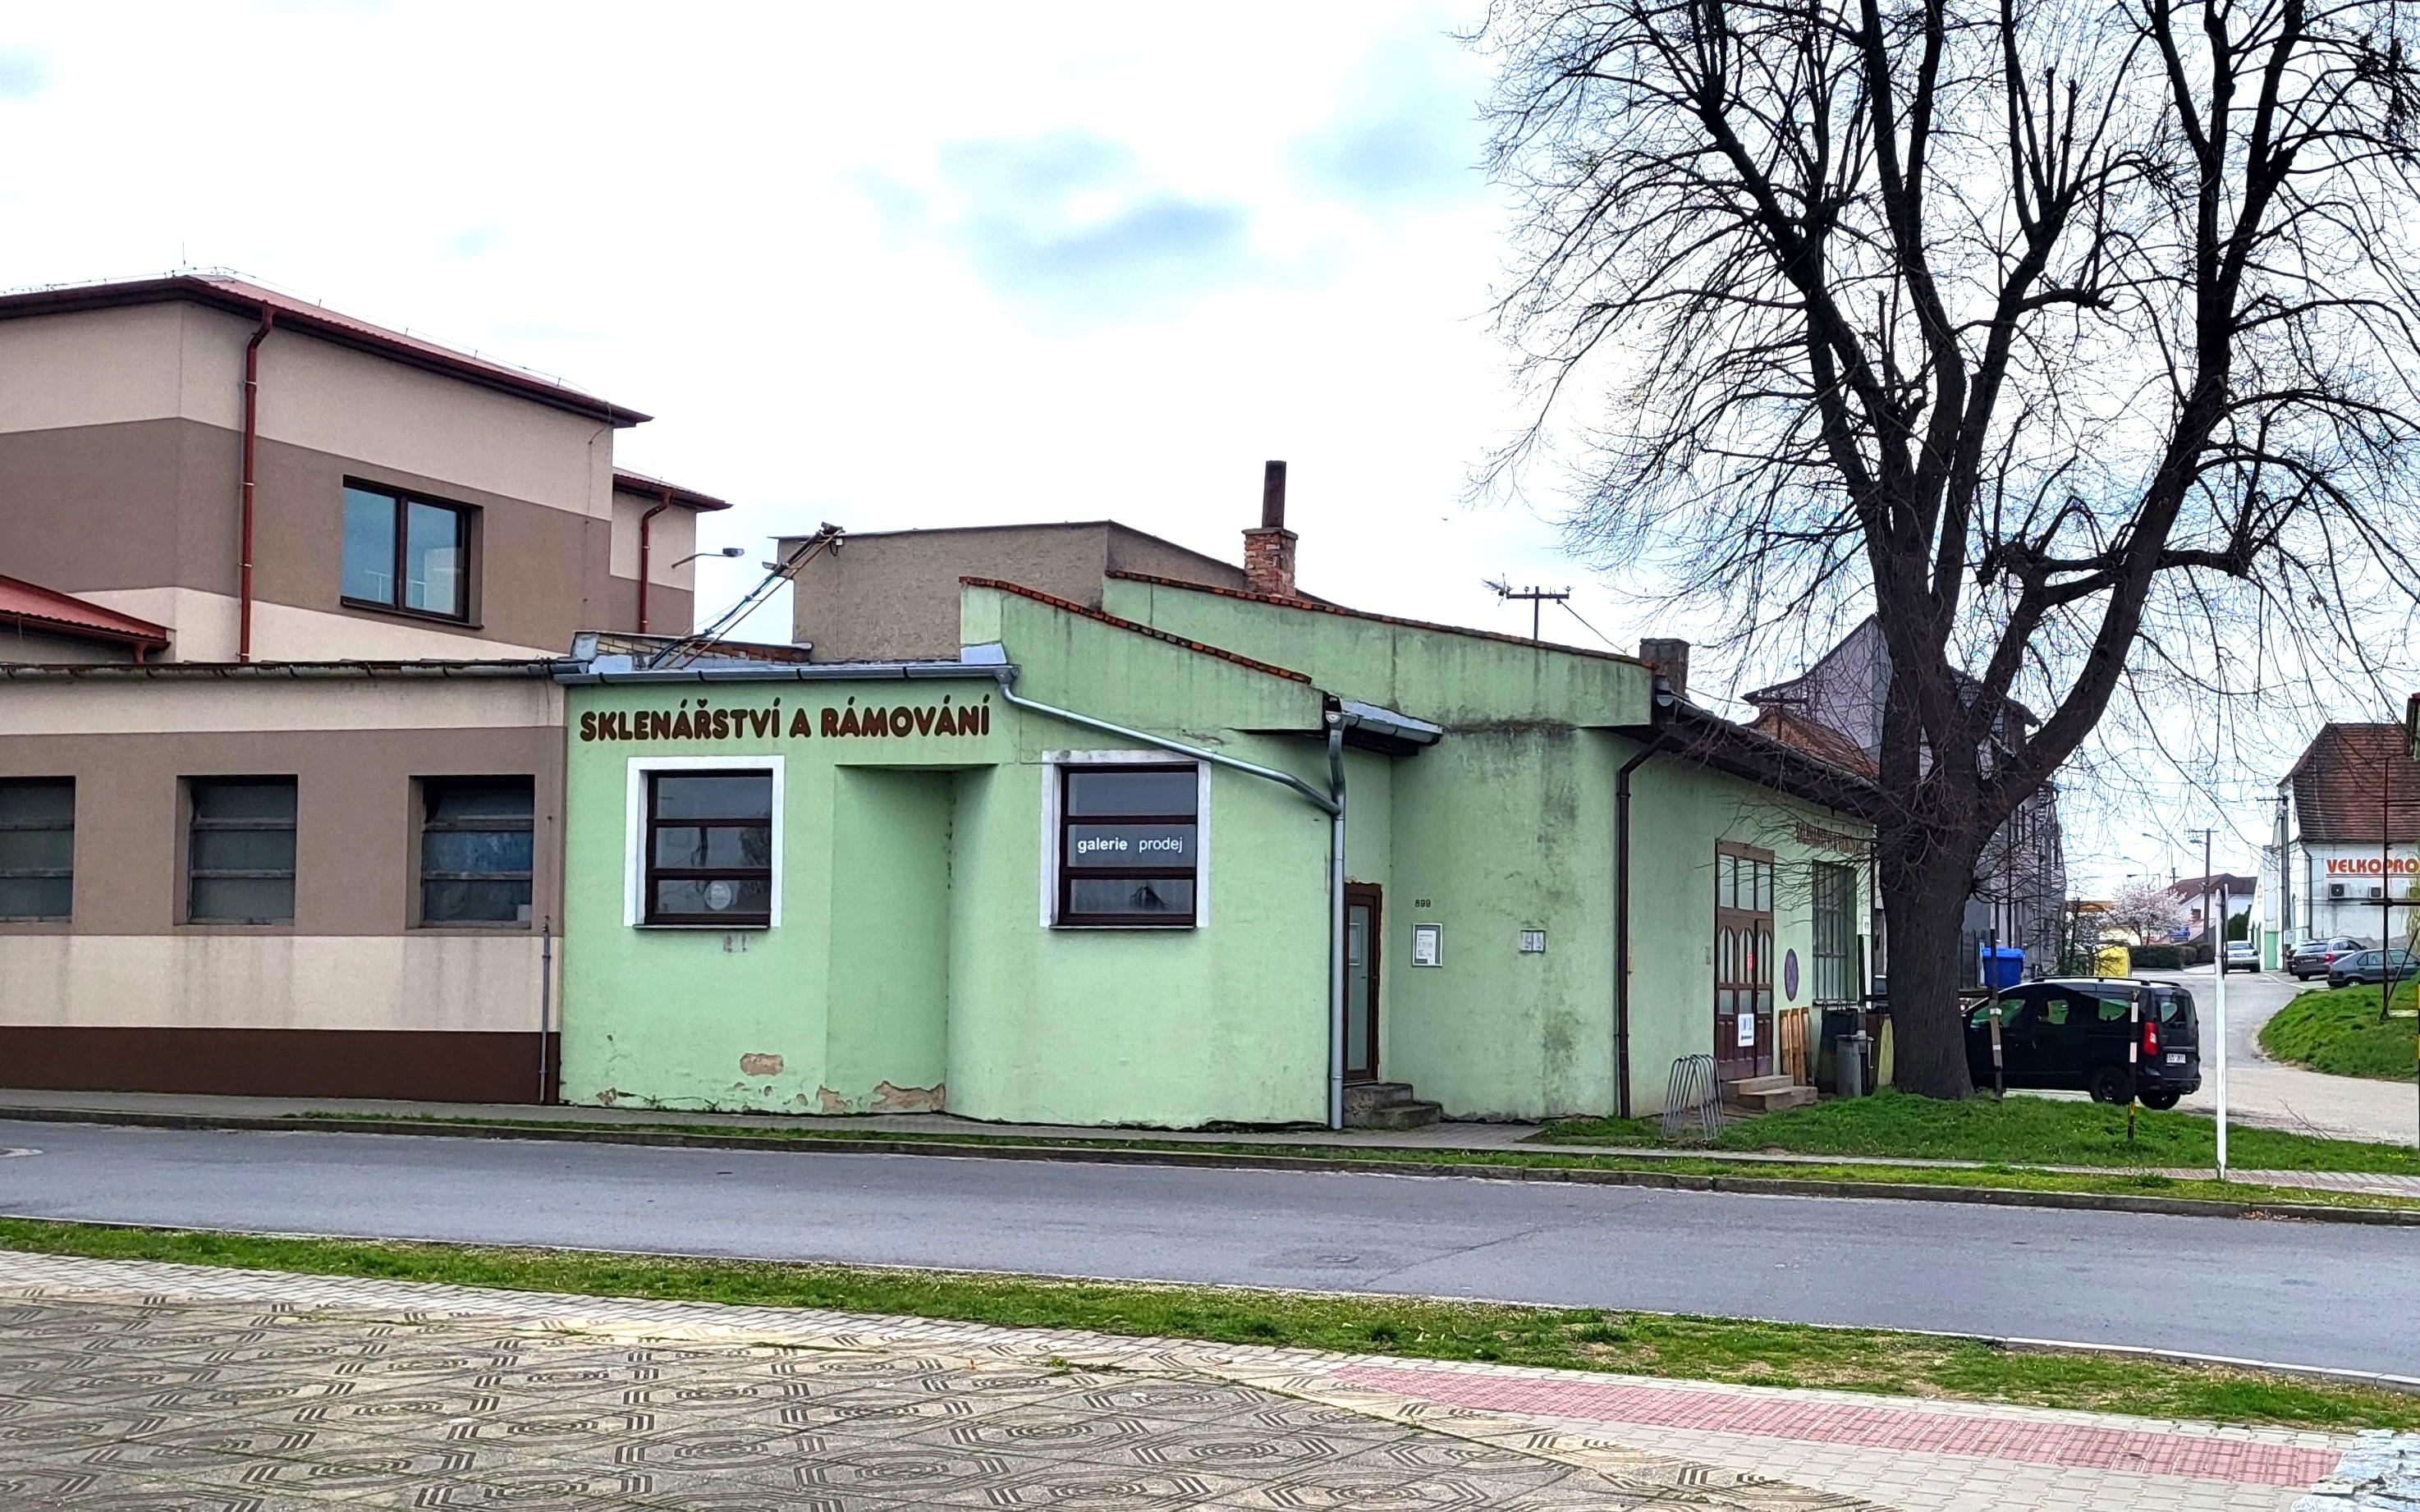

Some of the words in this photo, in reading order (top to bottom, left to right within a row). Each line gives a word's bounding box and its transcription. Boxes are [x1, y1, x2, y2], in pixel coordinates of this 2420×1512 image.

[580, 697, 781, 742] SKLENÁŘSTVÍ
[789, 708, 812, 738] A
[821, 694, 990, 738] RÁMOVÁNÍ
[1077, 836, 1128, 854] galerie
[1139, 836, 1183, 854] prodej
[2326, 859, 2419, 873] VELKOPRO
